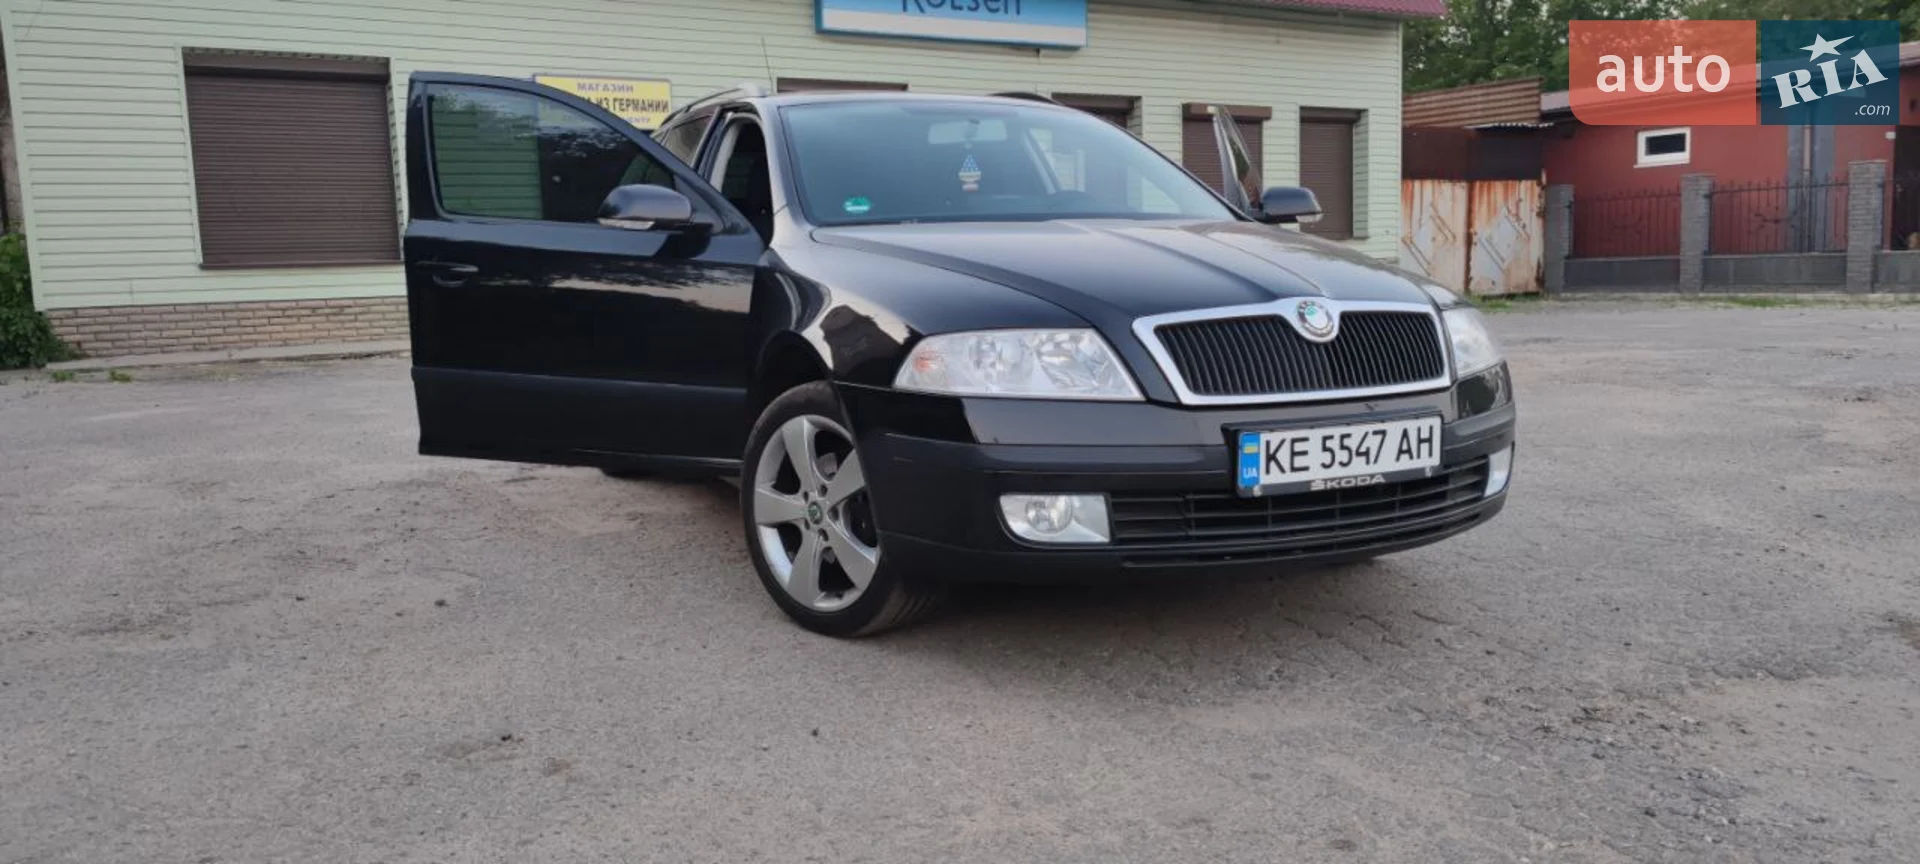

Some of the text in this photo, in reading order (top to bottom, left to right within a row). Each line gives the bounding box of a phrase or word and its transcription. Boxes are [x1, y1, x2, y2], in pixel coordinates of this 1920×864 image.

[577, 82, 634, 93] МАГАЗИН
[613, 97, 669, 113] ГЕРМАНИИ
[1265, 425, 1433, 475] KE 5547 AH
[1243, 467, 1259, 479] UA
[1310, 474, 1386, 491] ŠKODA
